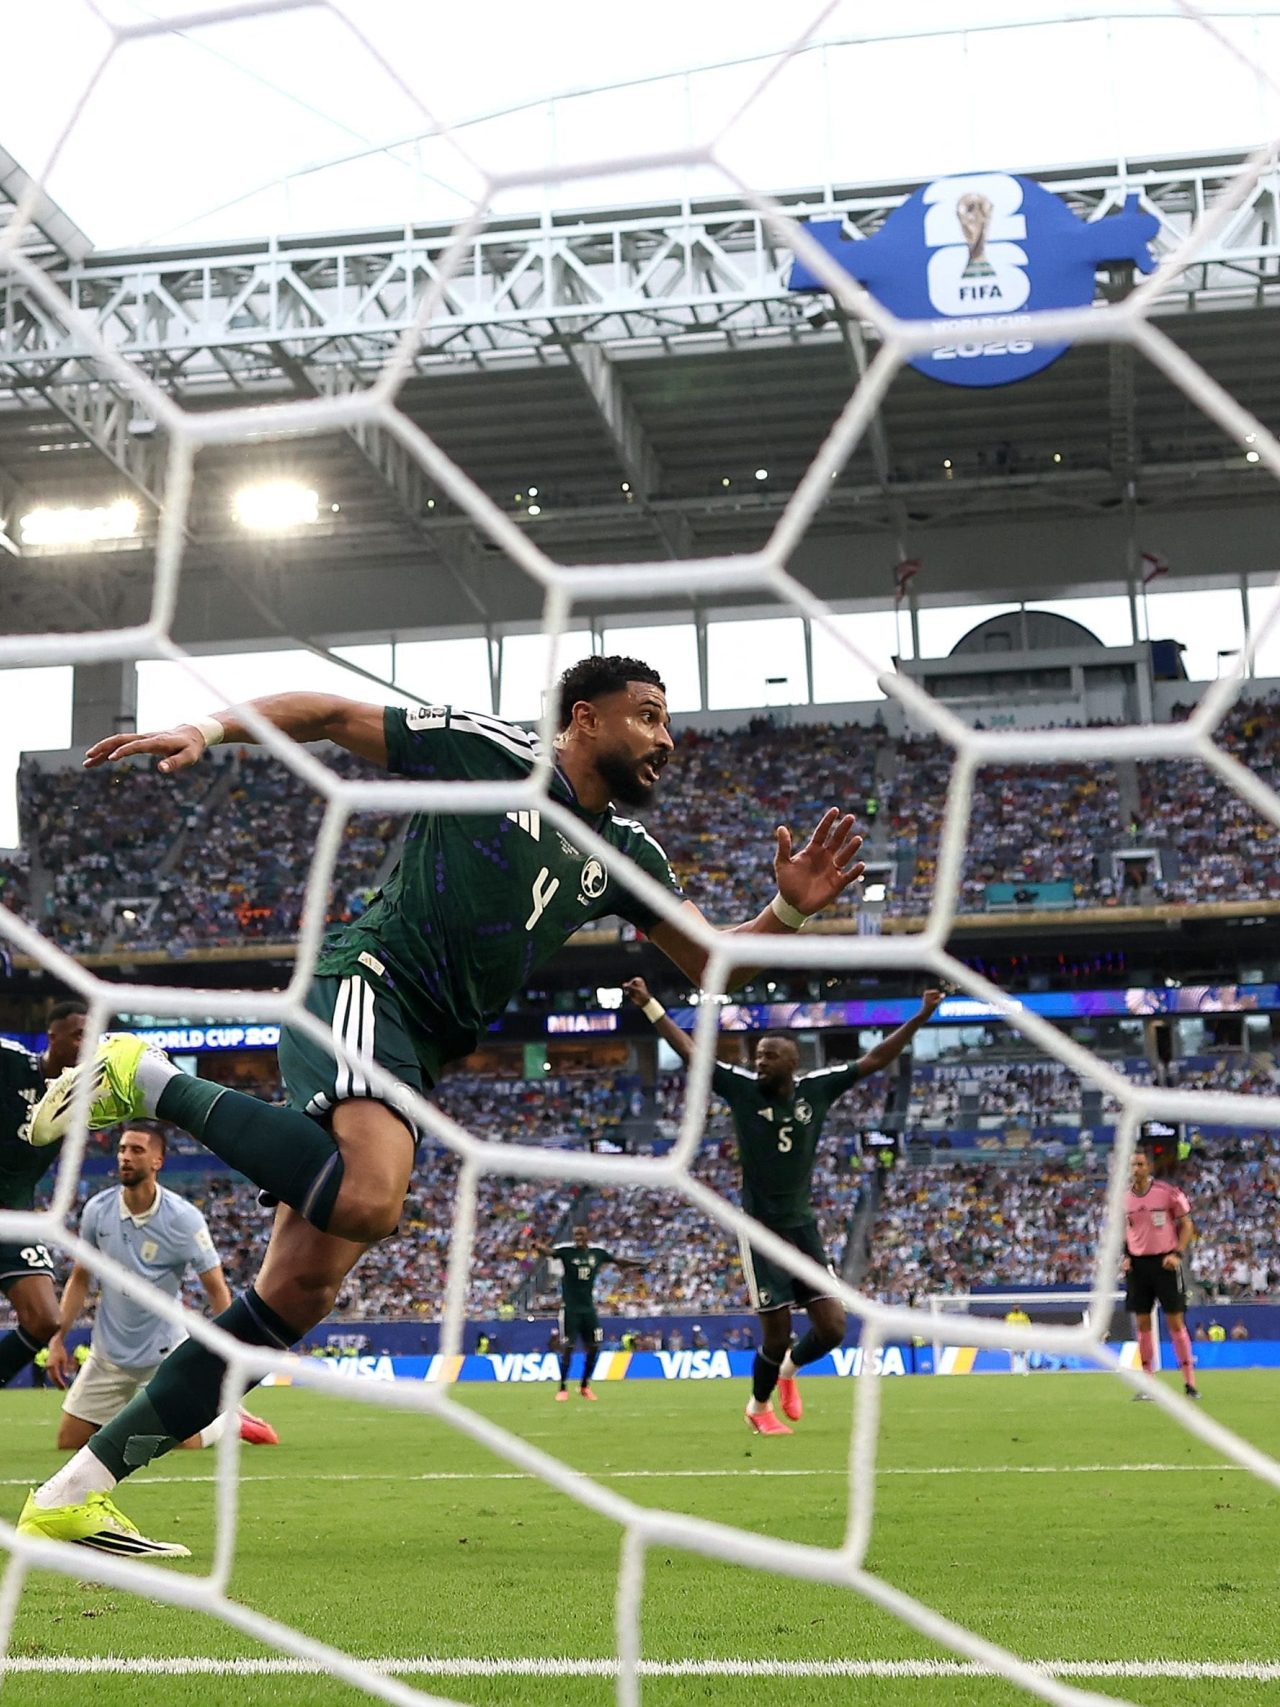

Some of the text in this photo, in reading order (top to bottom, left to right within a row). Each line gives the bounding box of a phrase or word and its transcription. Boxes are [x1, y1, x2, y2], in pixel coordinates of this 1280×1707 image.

[959, 285, 1003, 300] FIFA
[931, 338, 1035, 360] 2026
[525, 867, 561, 931] 4
[547, 1014, 618, 1033] MIAMI
[136, 1030, 205, 1050] WORLD
[206, 1029, 245, 1048] CUP
[245, 1026, 281, 1046] 20
[777, 1127, 793, 1152] 5
[320, 1356, 397, 1382] VISA
[486, 1353, 562, 1382] VISA
[654, 1350, 733, 1380] VISA
[829, 1346, 906, 1377] VISA
